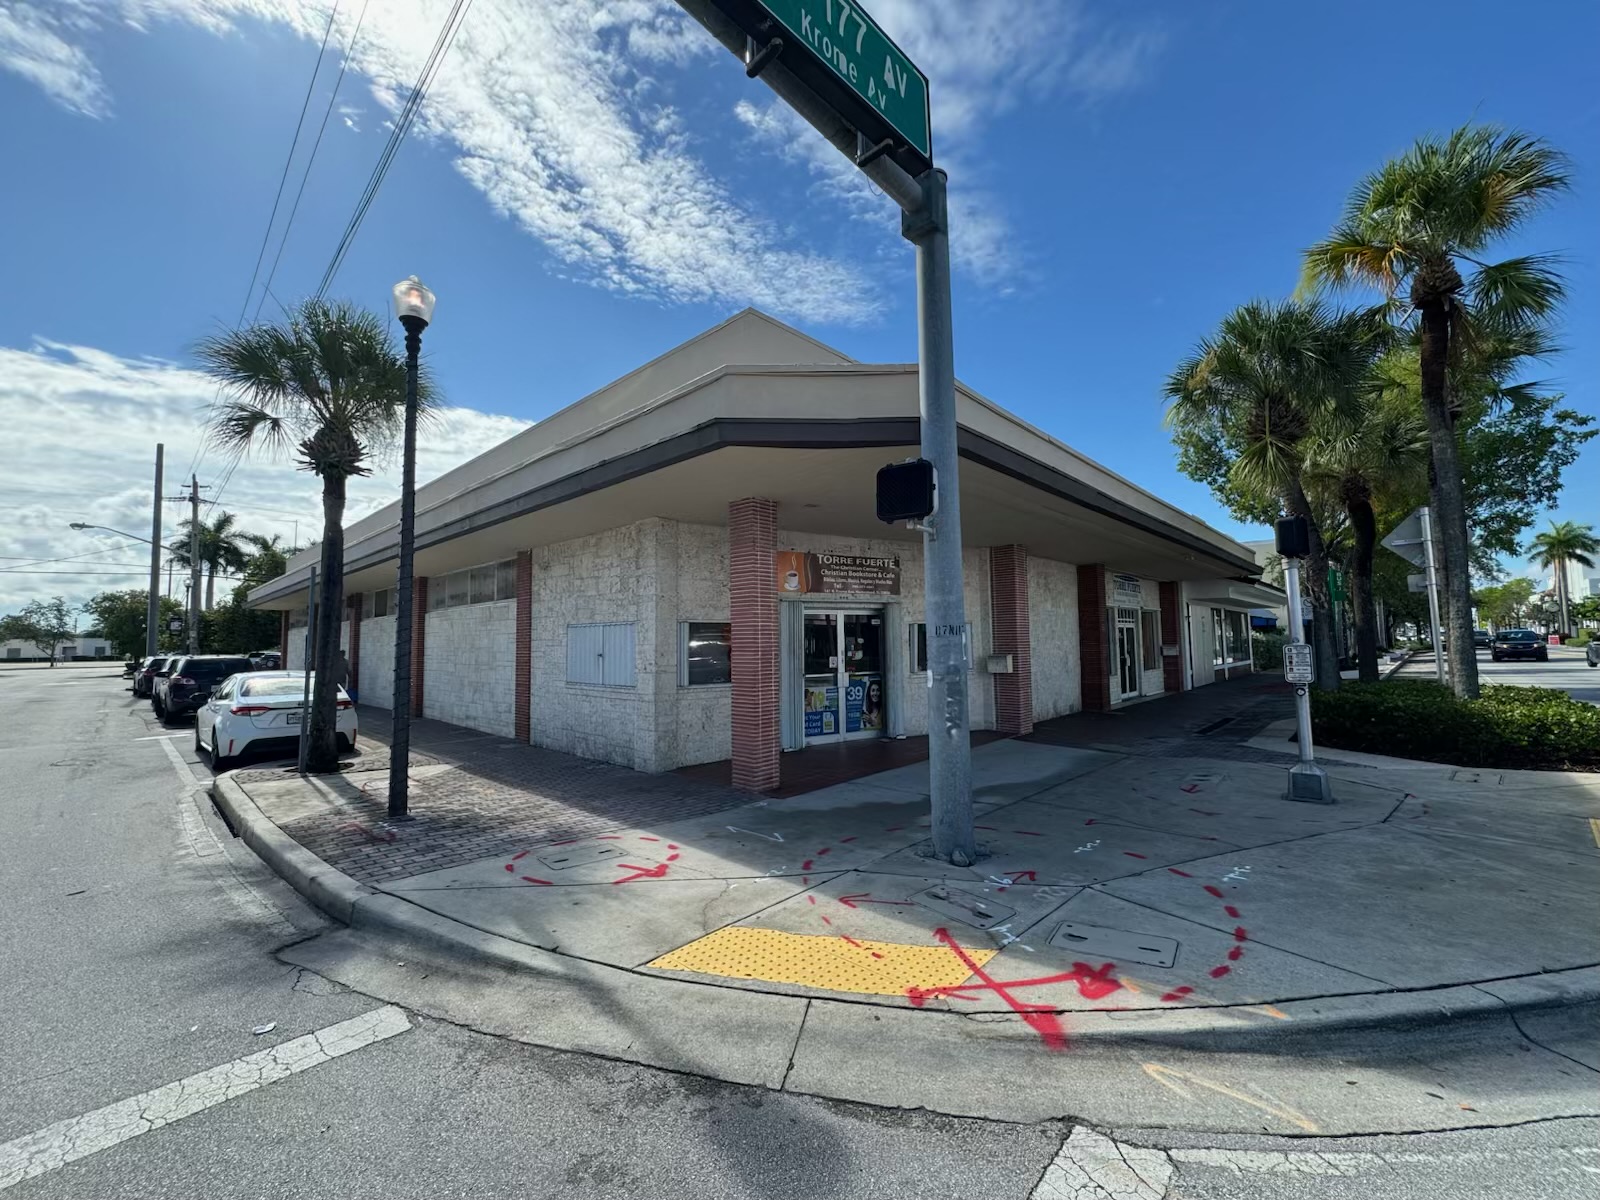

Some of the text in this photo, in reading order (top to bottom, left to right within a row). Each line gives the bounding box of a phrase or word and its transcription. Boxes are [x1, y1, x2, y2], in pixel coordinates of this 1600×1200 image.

[801, 8, 857, 83] Krome
[817, 554, 896, 568] TORRE FUERTE
[847, 687, 863, 700] 39
